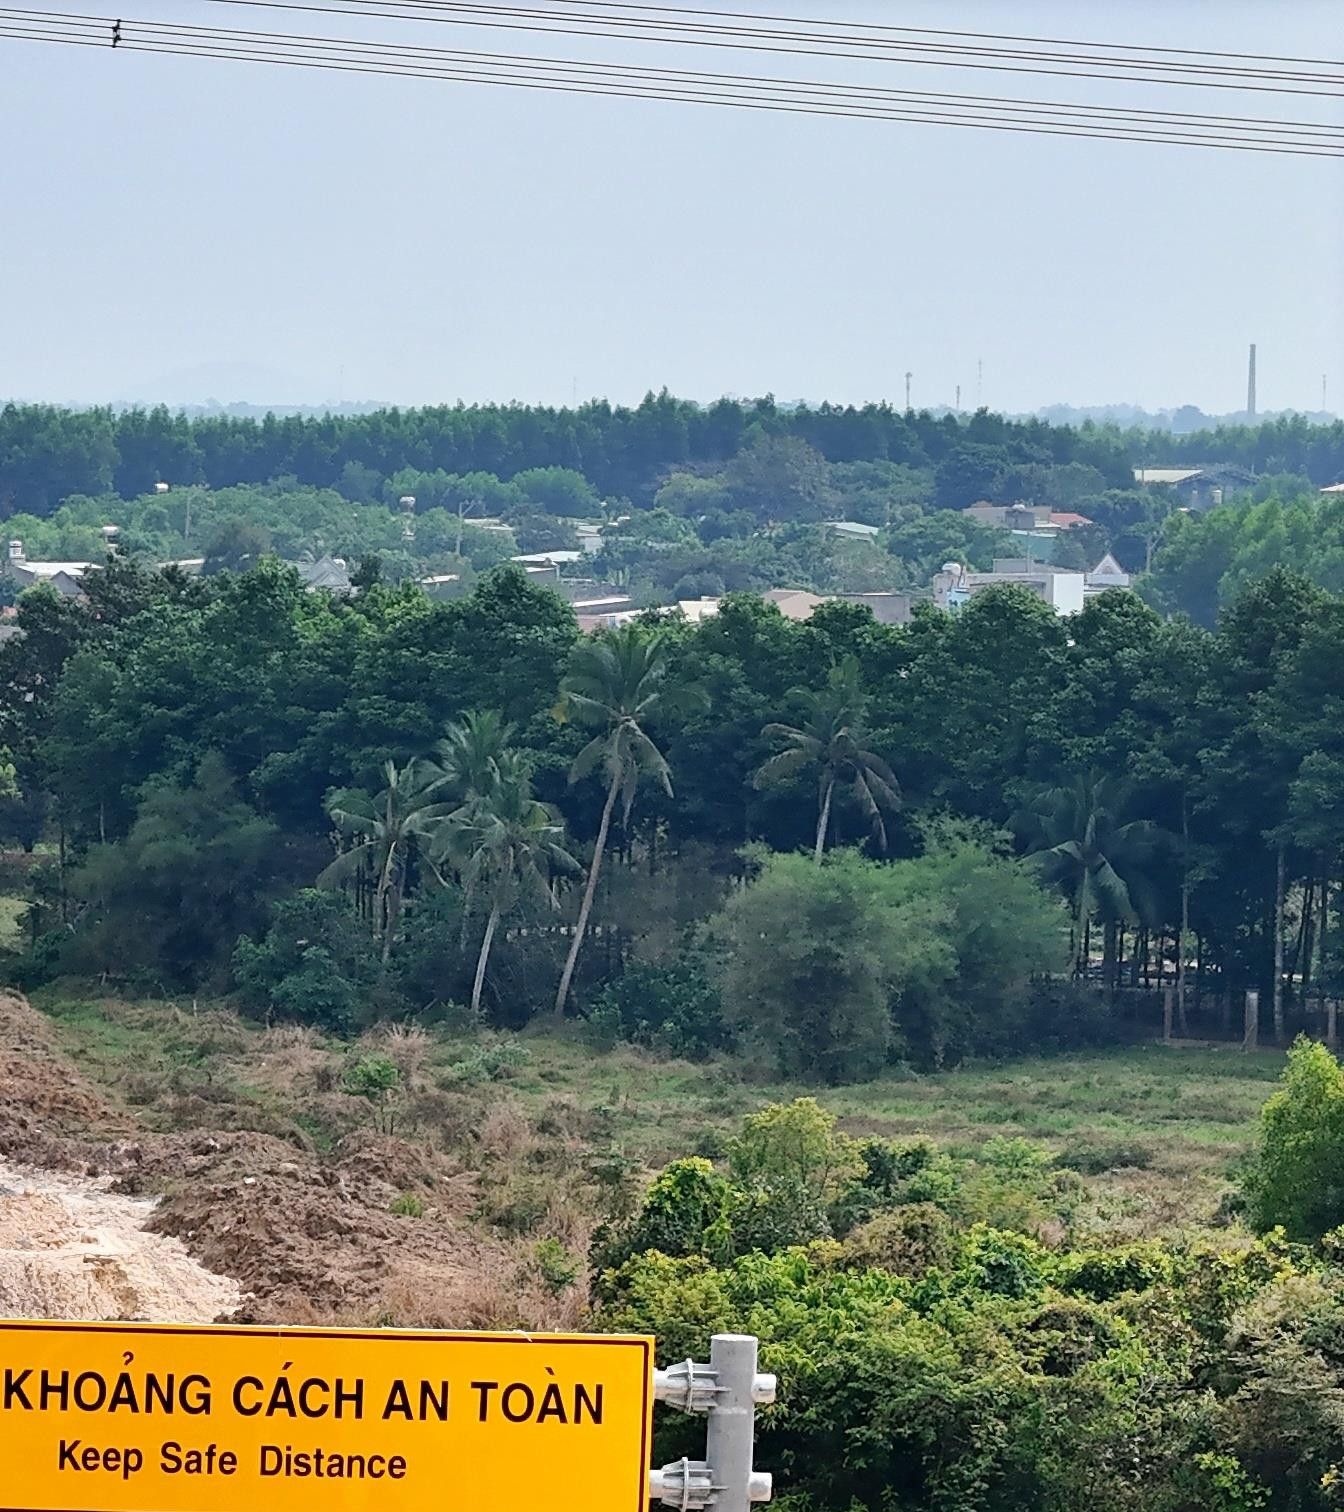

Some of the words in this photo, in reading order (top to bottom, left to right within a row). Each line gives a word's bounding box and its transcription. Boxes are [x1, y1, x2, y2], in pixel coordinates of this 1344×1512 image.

[4, 1351, 211, 1415] KHOẢNG
[232, 1361, 363, 1420] CÁCH
[381, 1379, 449, 1421] AN
[473, 1367, 605, 1425] TOÀN
[58, 1439, 143, 1480] Keep
[160, 1441, 238, 1475] Safe
[260, 1445, 408, 1479] Distance
